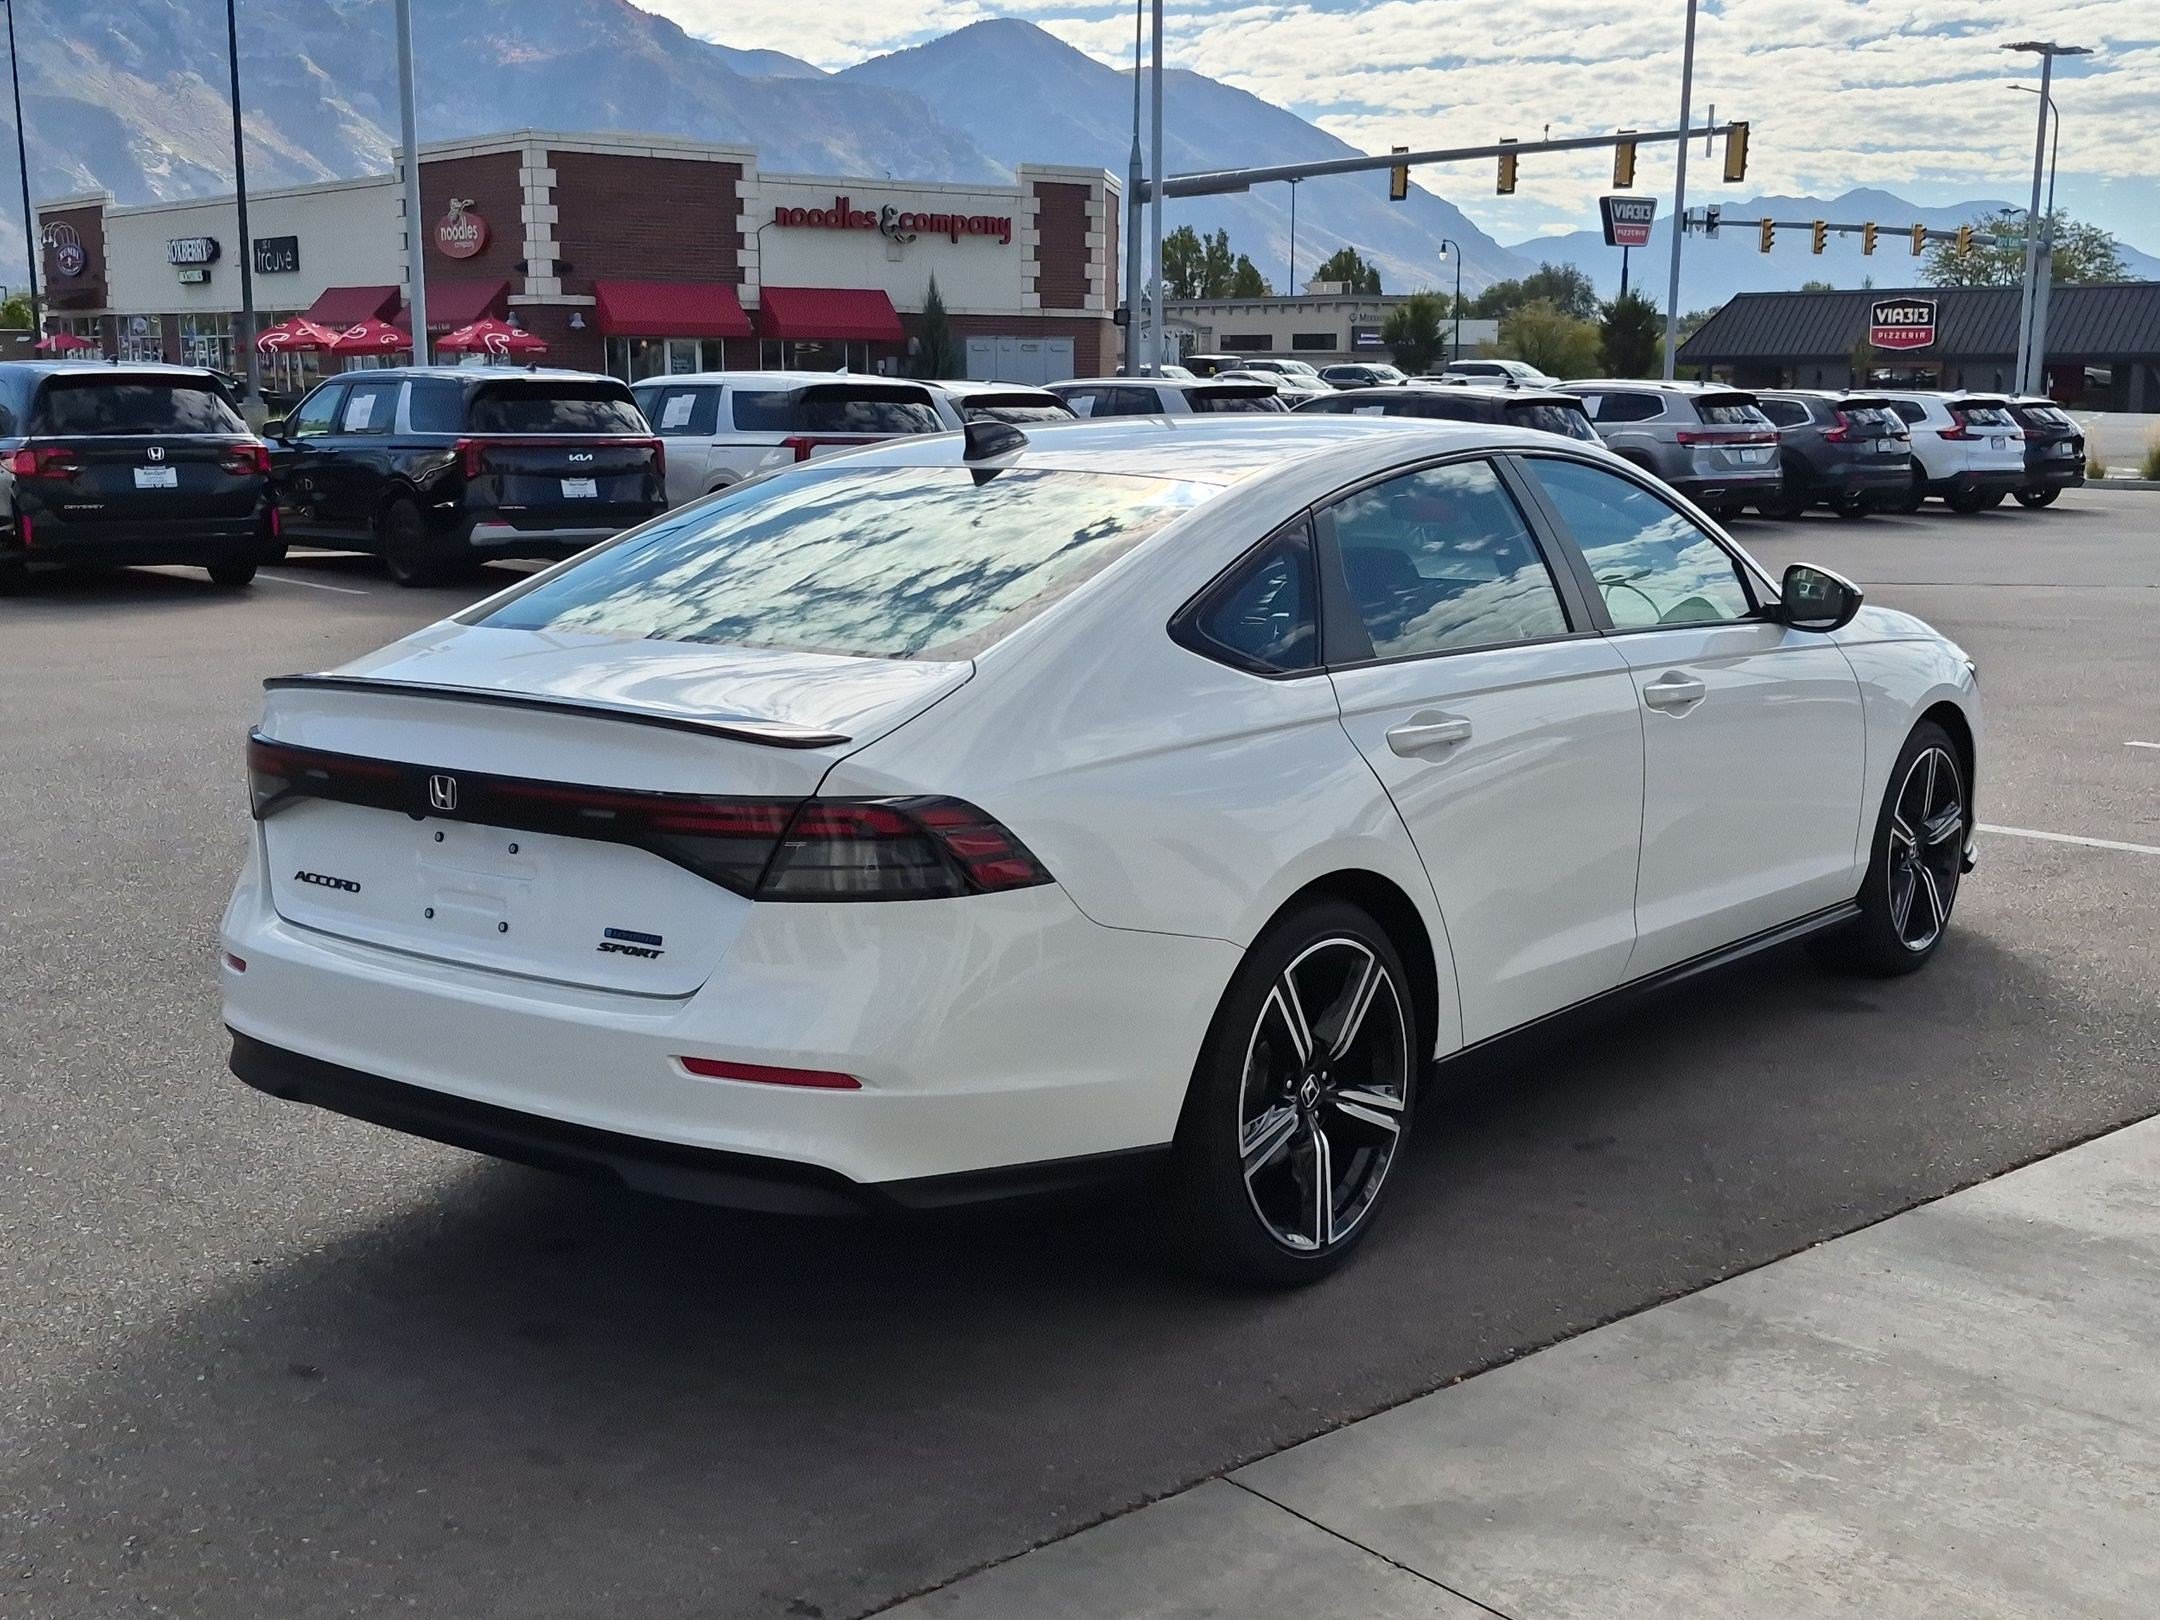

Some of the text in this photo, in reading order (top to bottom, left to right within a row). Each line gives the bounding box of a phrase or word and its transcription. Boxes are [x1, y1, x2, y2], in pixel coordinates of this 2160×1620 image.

[775, 196, 877, 229] noodles
[900, 212, 1012, 245] company
[1613, 203, 1652, 220] VIA313
[440, 215, 478, 241] noodles
[166, 238, 208, 264] ROXBERRY
[1875, 307, 1929, 324] VIA313
[1877, 331, 1926, 340] PIZZERIA
[294, 870, 361, 893] ACCORD
[596, 942, 665, 960] SPORT
